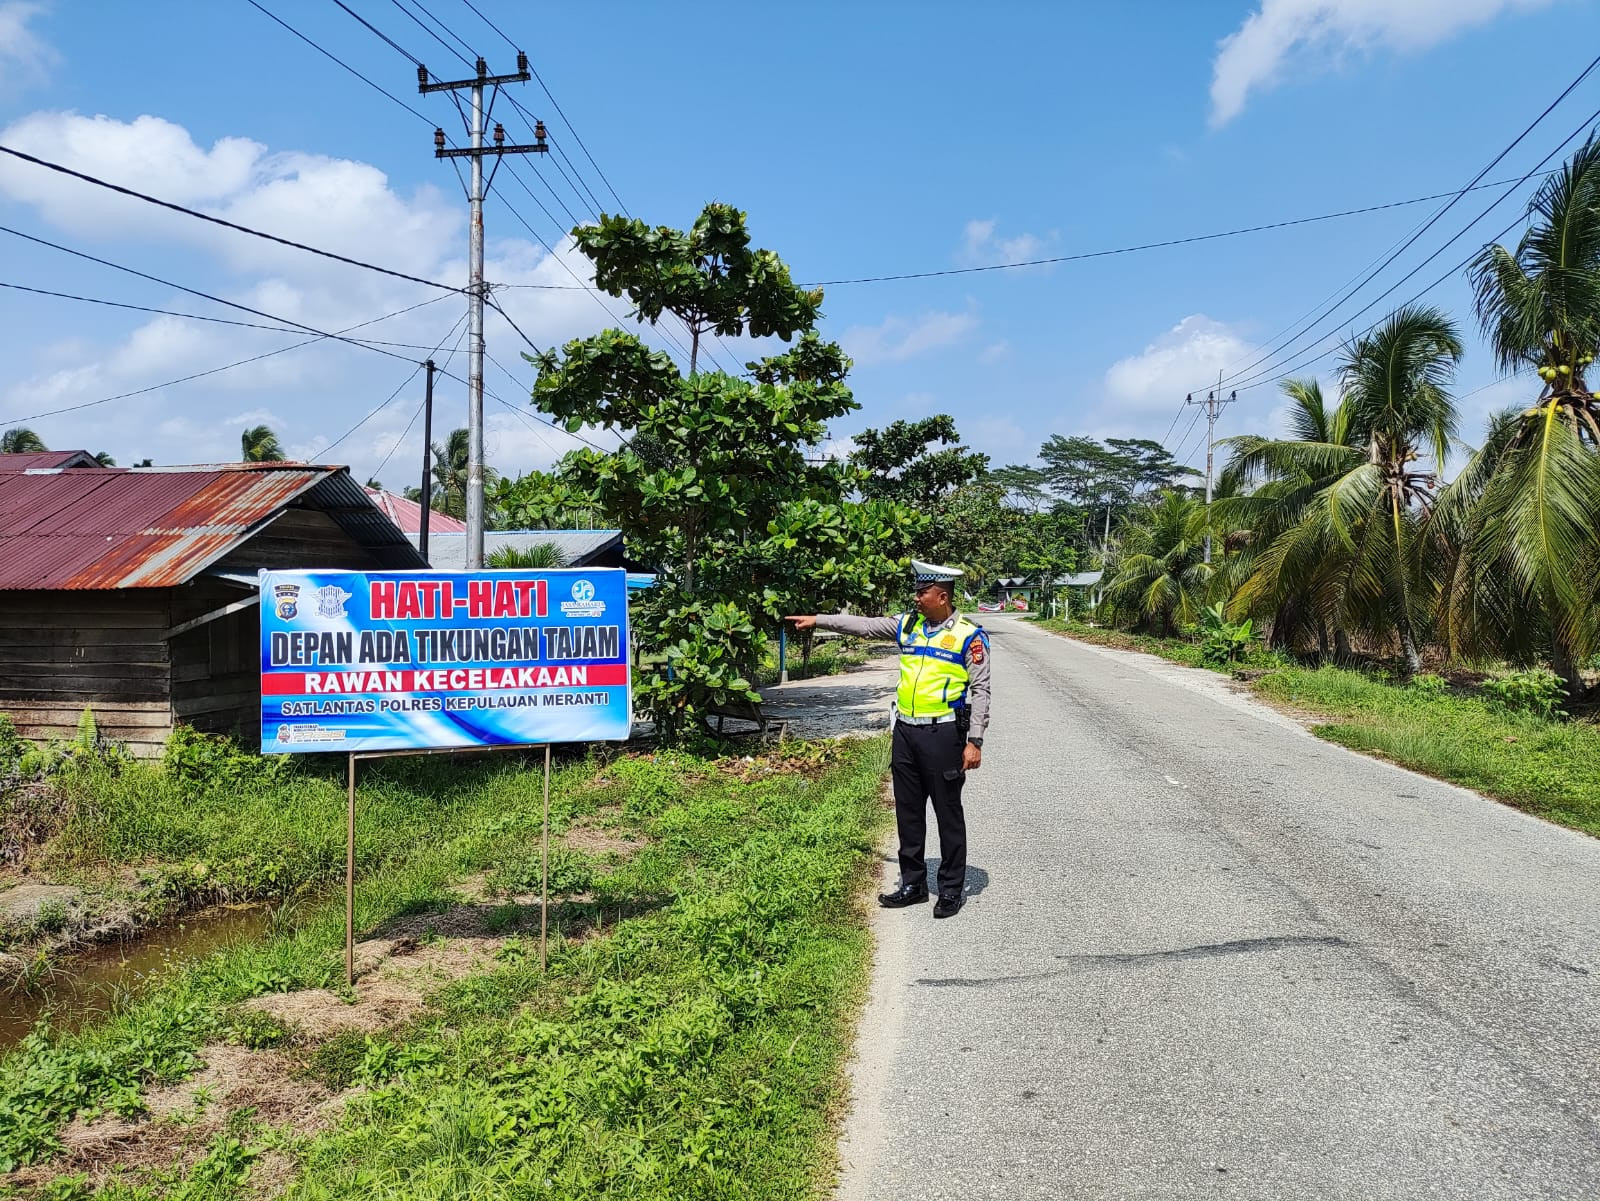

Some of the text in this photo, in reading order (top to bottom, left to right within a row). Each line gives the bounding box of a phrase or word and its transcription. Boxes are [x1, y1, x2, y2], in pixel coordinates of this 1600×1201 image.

[371, 581, 547, 619] HATI-HATI
[272, 626, 619, 666] DEPAN ADA TIKUNGAN TAJAM
[305, 666, 587, 693] RAWAN KECELAKAAN
[282, 692, 609, 716] SATLANTAS POLRES KEPULAUAN MERANTI
